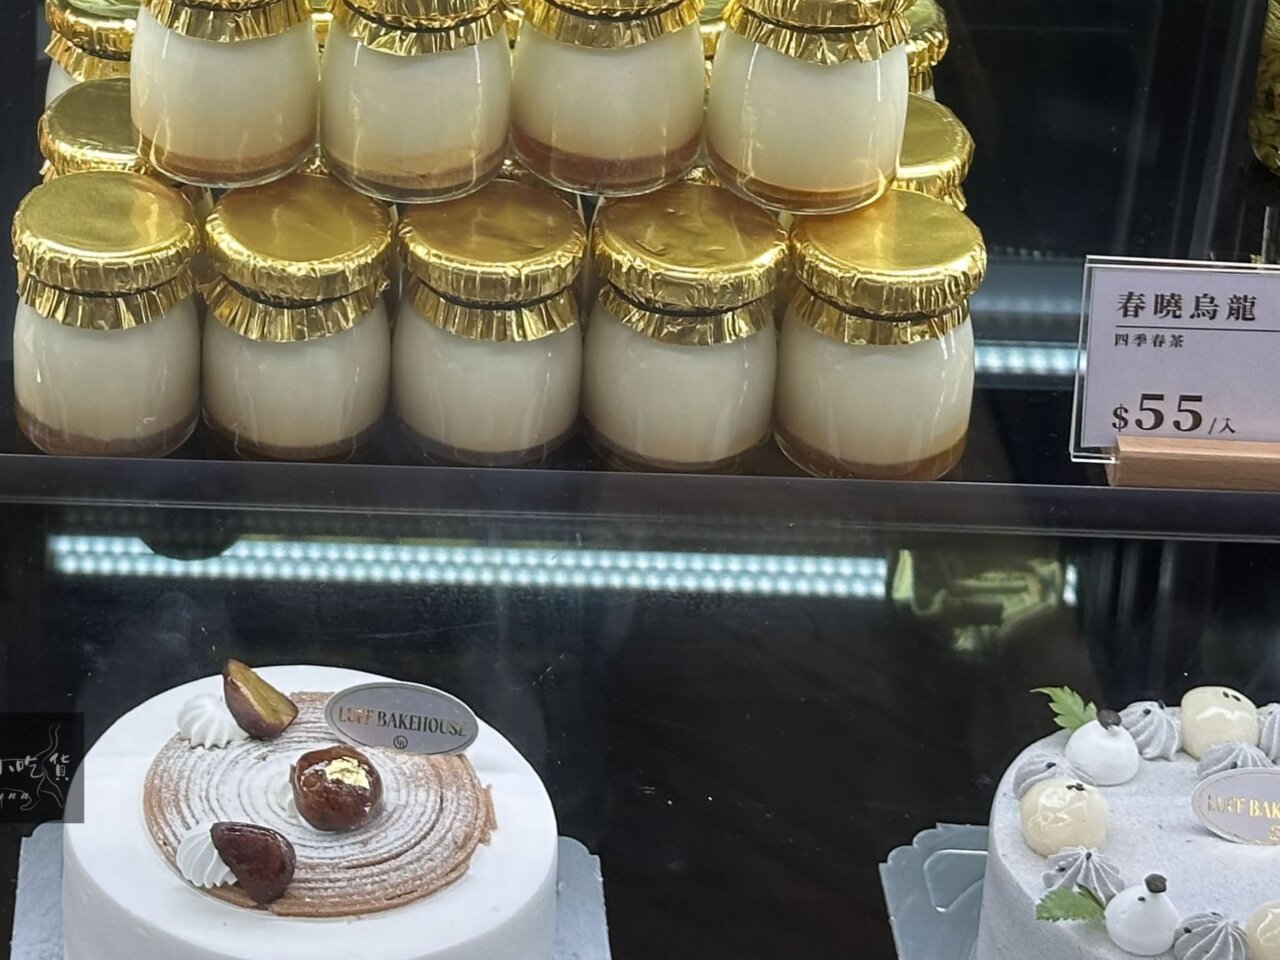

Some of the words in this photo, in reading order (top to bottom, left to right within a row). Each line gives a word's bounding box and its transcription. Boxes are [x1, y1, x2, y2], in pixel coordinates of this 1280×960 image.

[1116, 292, 1257, 322] 春曉烏龍
[1114, 333, 1185, 348] 四季春茶
[1112, 393, 1236, 435] $55/入
[378, 711, 467, 738] BAKEHOUSE
